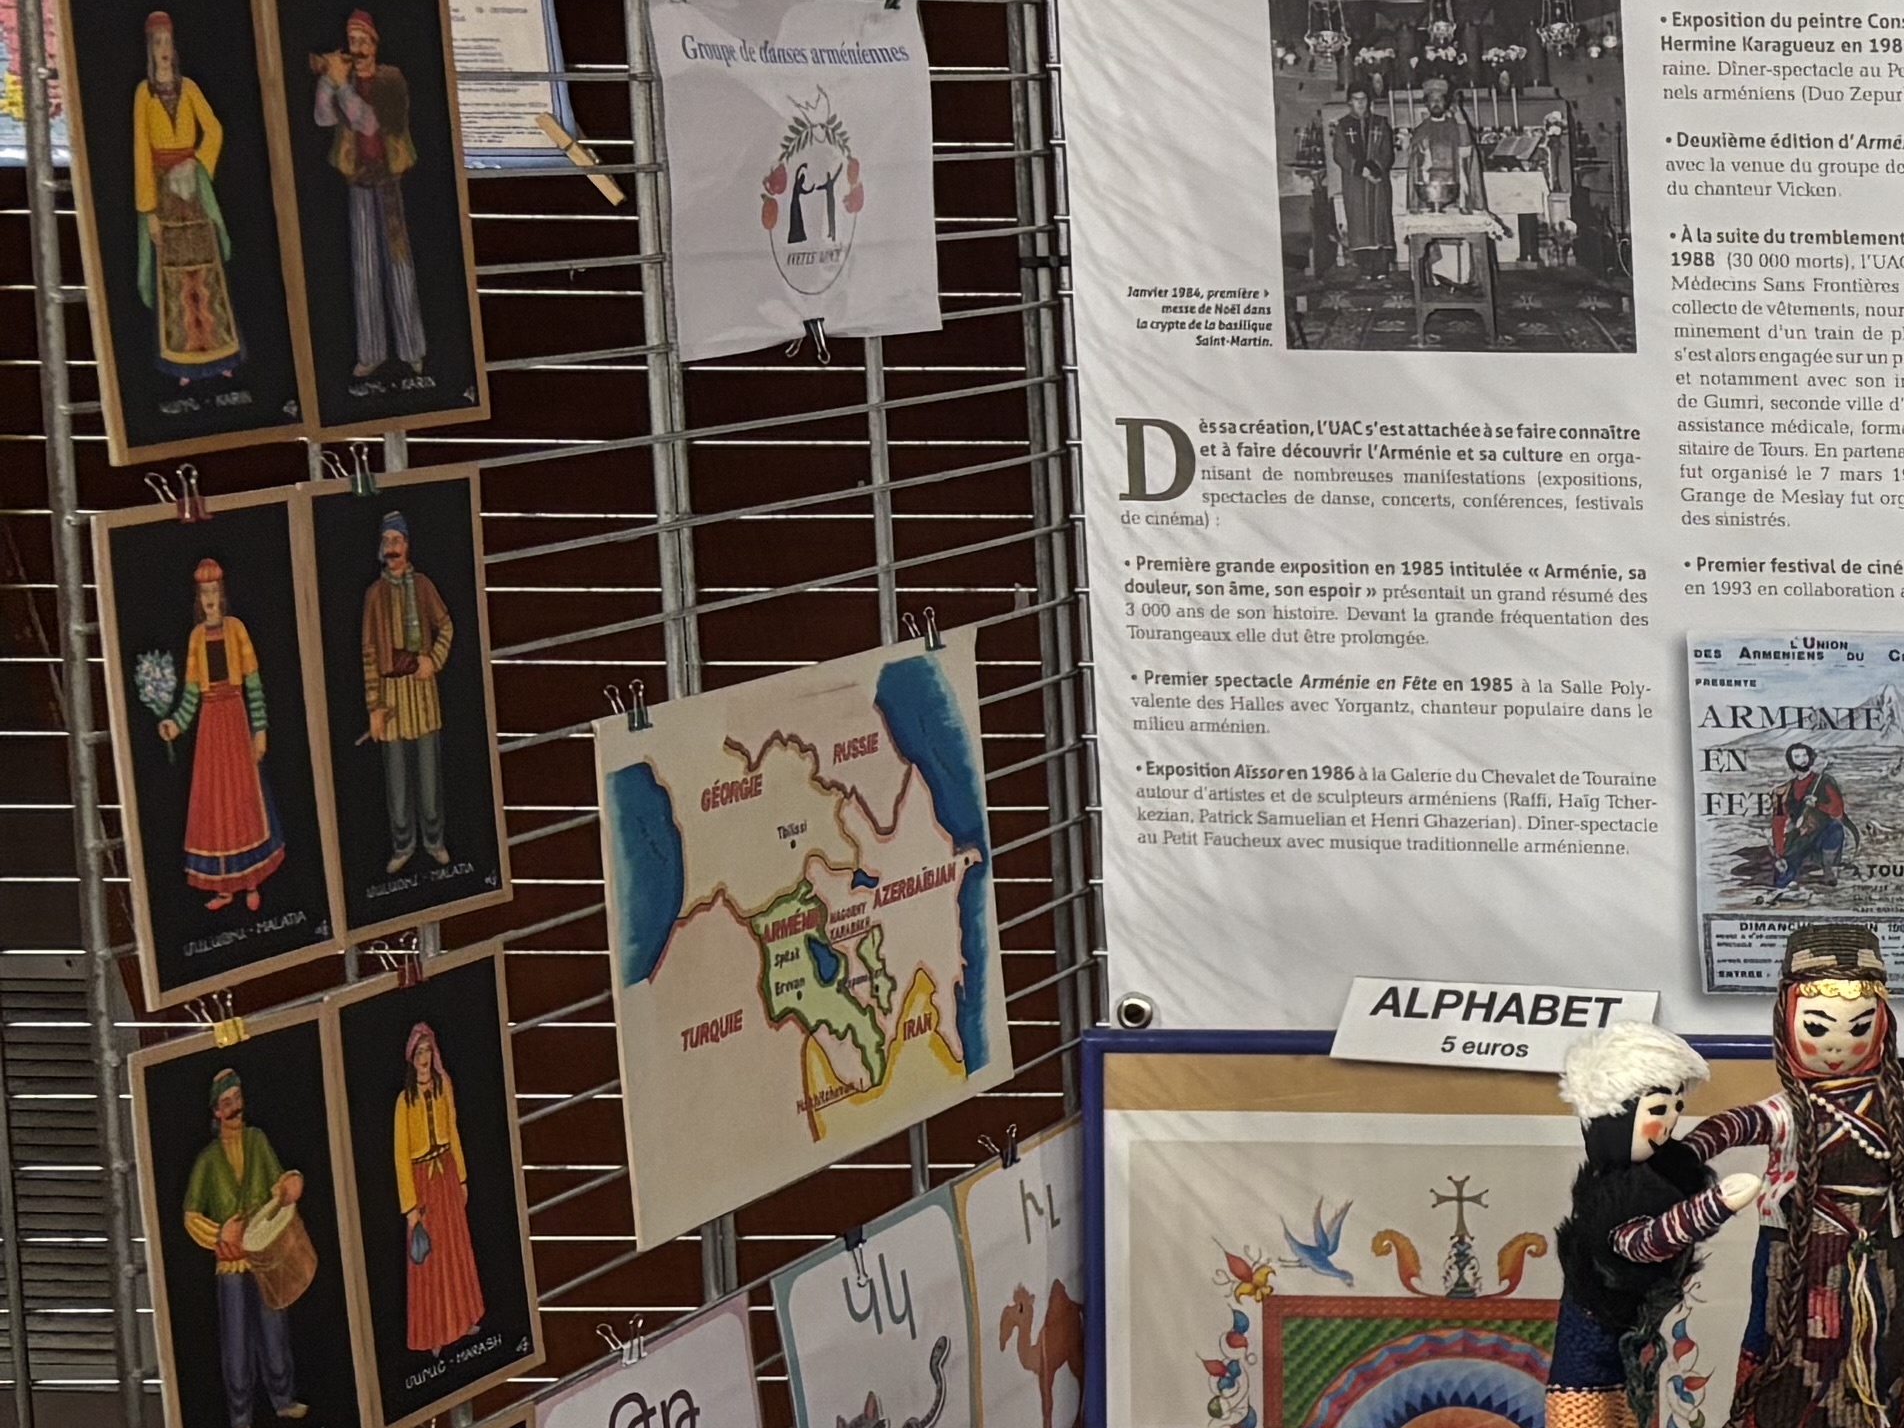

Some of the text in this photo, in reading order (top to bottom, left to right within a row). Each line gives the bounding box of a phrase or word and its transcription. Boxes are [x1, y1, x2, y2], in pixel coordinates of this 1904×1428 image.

[681, 34, 910, 67] Groupe de danses arméniennes
[1698, 704, 1885, 731] ARMENIE
[832, 732, 880, 766] RUSSIE
[1700, 747, 1748, 773] EN
[700, 772, 764, 813] GÉORGIE
[872, 862, 957, 911] AZERBAÏDJAN
[1369, 986, 1623, 1029] ALPHABET
[680, 1009, 744, 1052] TURQUIE
[903, 1012, 933, 1042] IRAN
[1441, 1035, 1530, 1058] 5 euros
